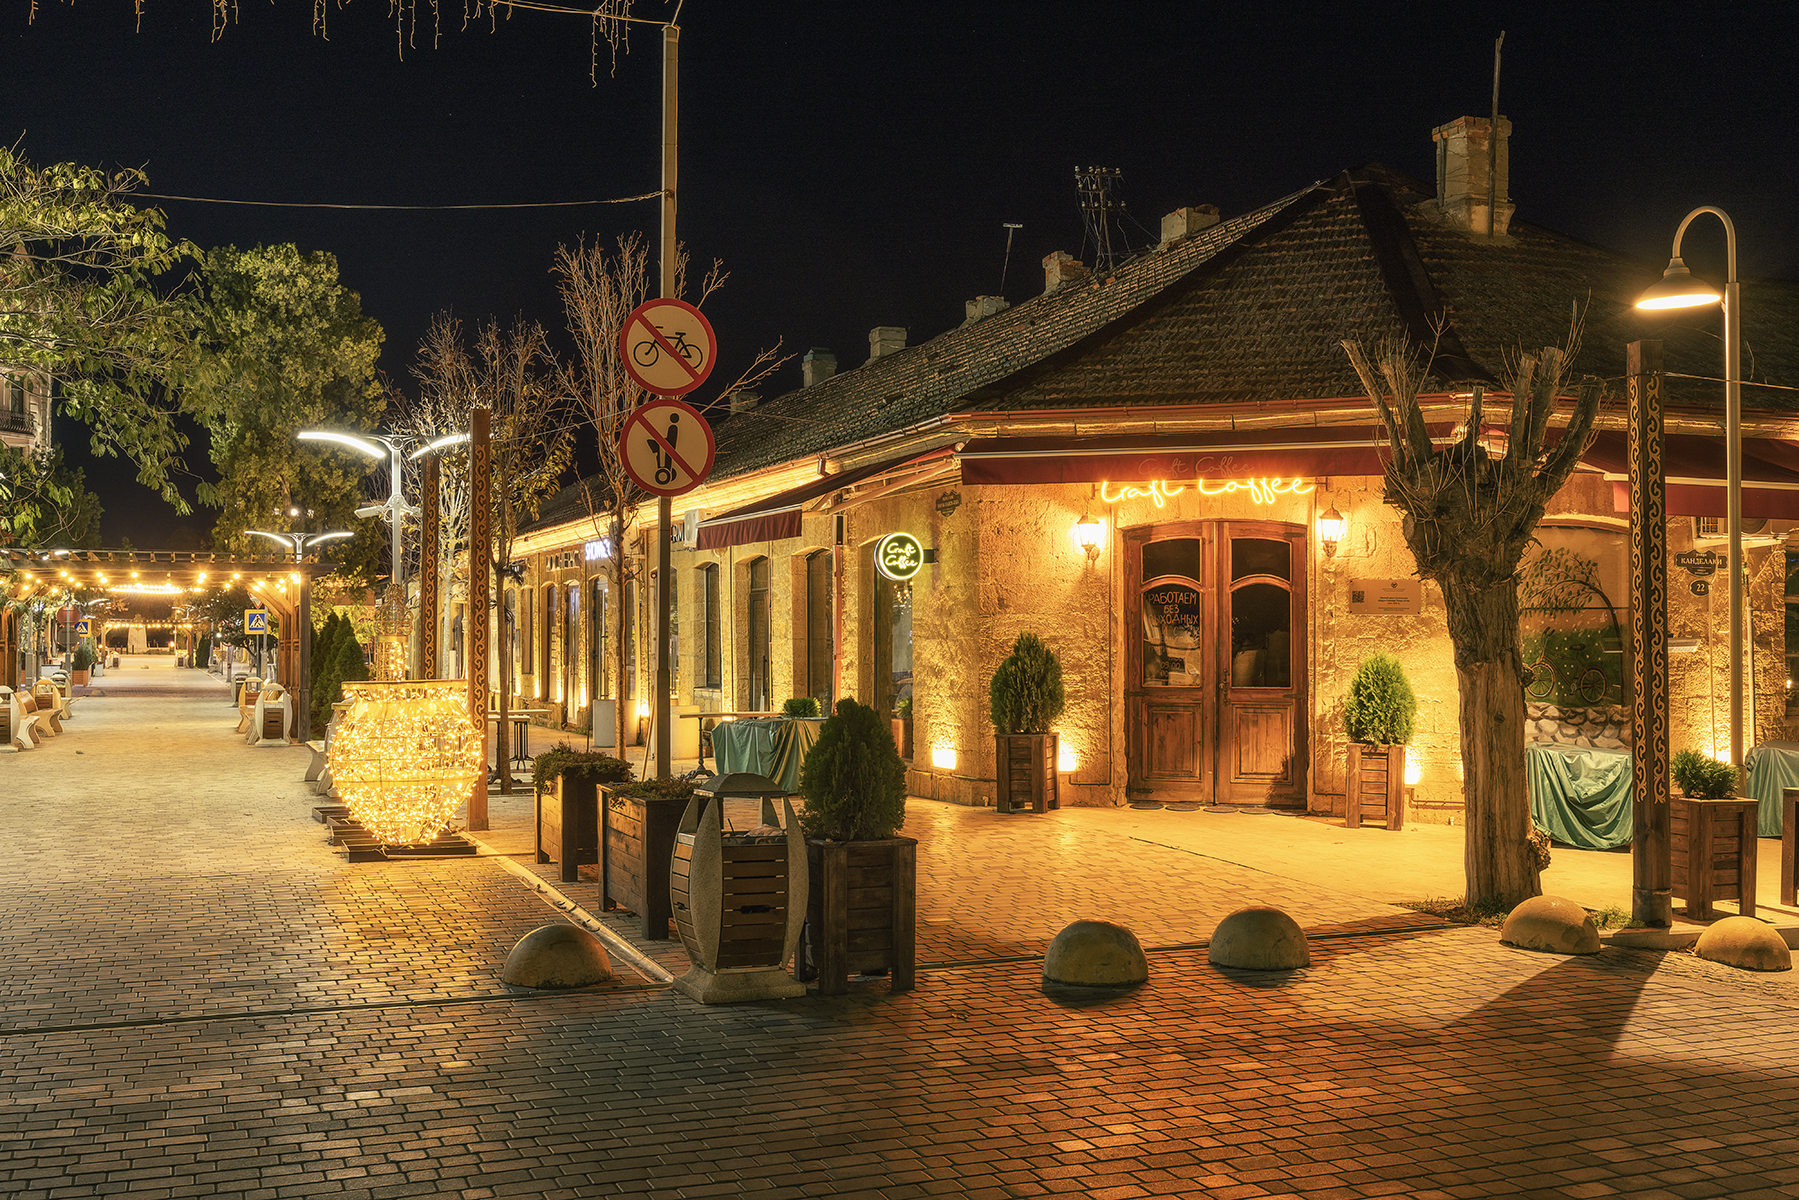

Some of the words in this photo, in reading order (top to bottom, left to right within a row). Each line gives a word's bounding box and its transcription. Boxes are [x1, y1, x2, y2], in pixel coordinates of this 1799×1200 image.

[1138, 457, 1188, 478] Craft
[1195, 456, 1254, 477] Coffee
[887, 542, 916, 557] Craft
[885, 555, 918, 569] Coffee
[1696, 583, 1705, 592] 22
[1148, 591, 1197, 605] РАБОТАЕМ
[1163, 604, 1180, 614] БЕЗ
